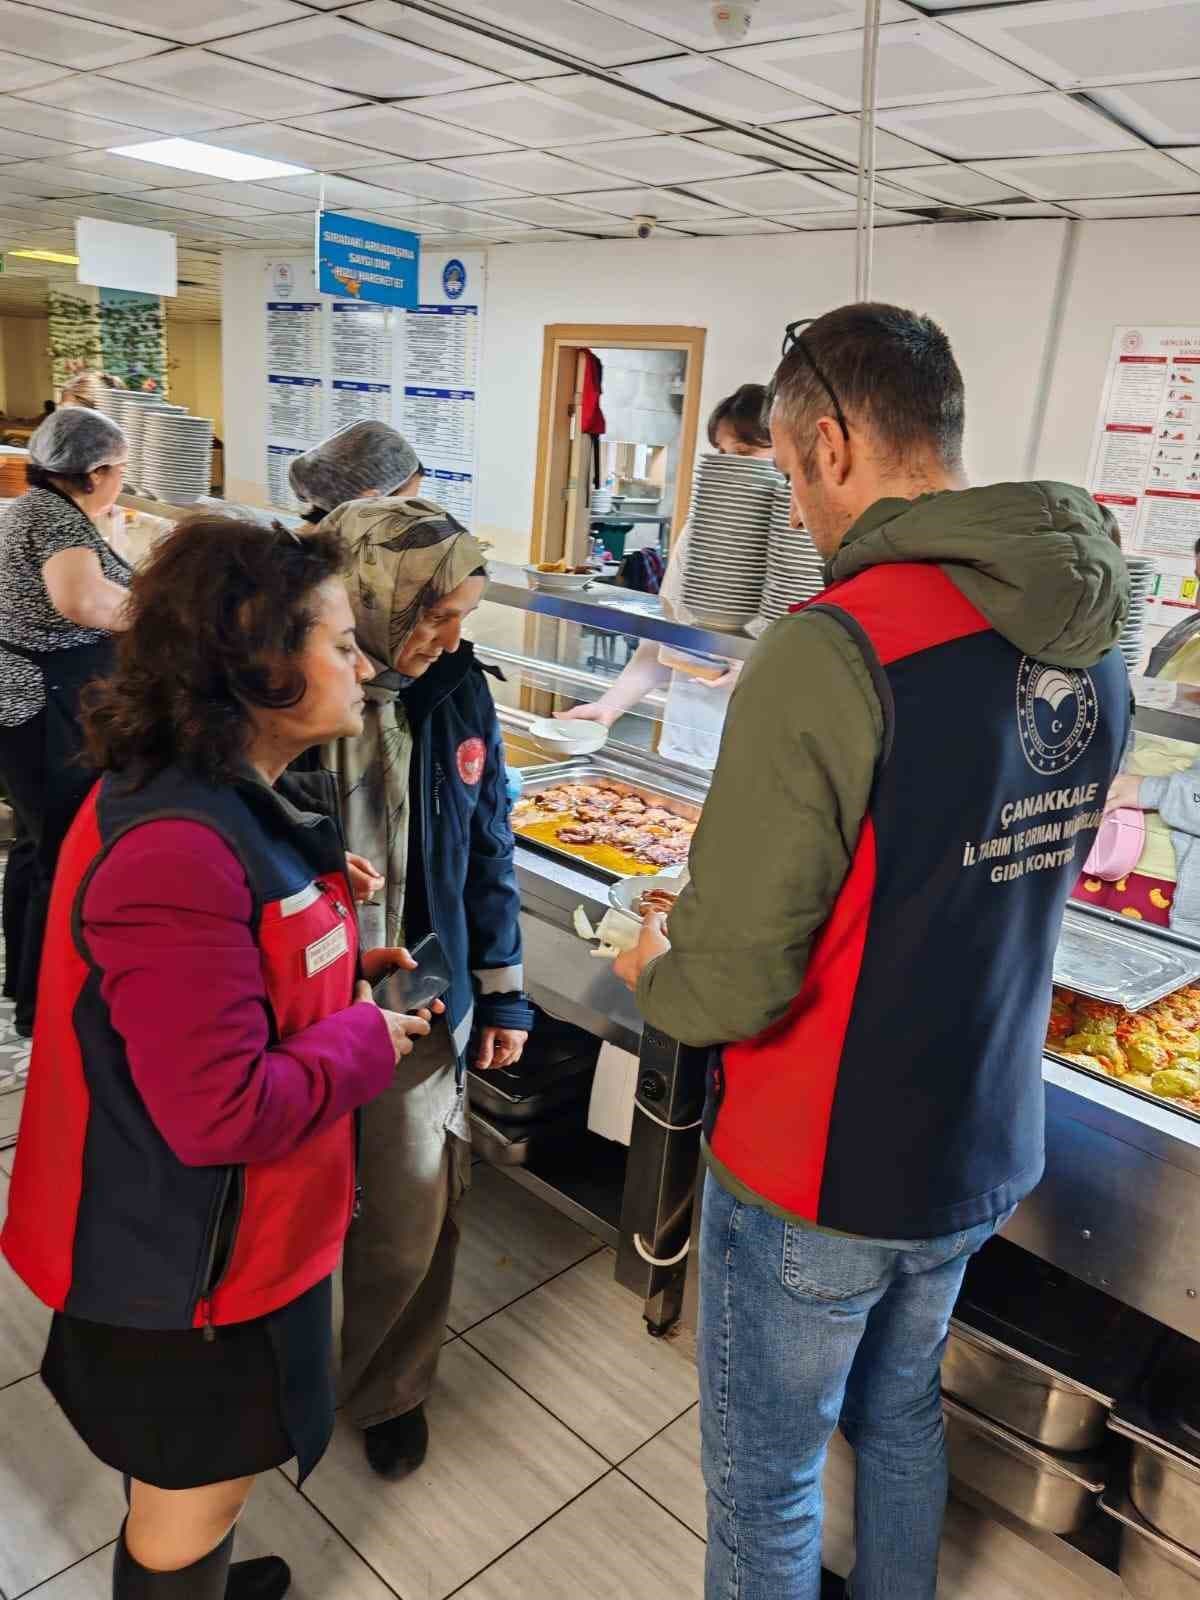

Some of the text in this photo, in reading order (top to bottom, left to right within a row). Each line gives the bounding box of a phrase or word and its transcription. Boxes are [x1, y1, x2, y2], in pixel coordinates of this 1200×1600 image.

[1001, 783, 1099, 830] ÇANAKKALE
[962, 841, 976, 867] İL
[978, 835, 1013, 862] TARIM
[1014, 831, 1025, 853] VE
[1025, 823, 1062, 848] ORMAN
[991, 863, 1024, 883] GIDA
